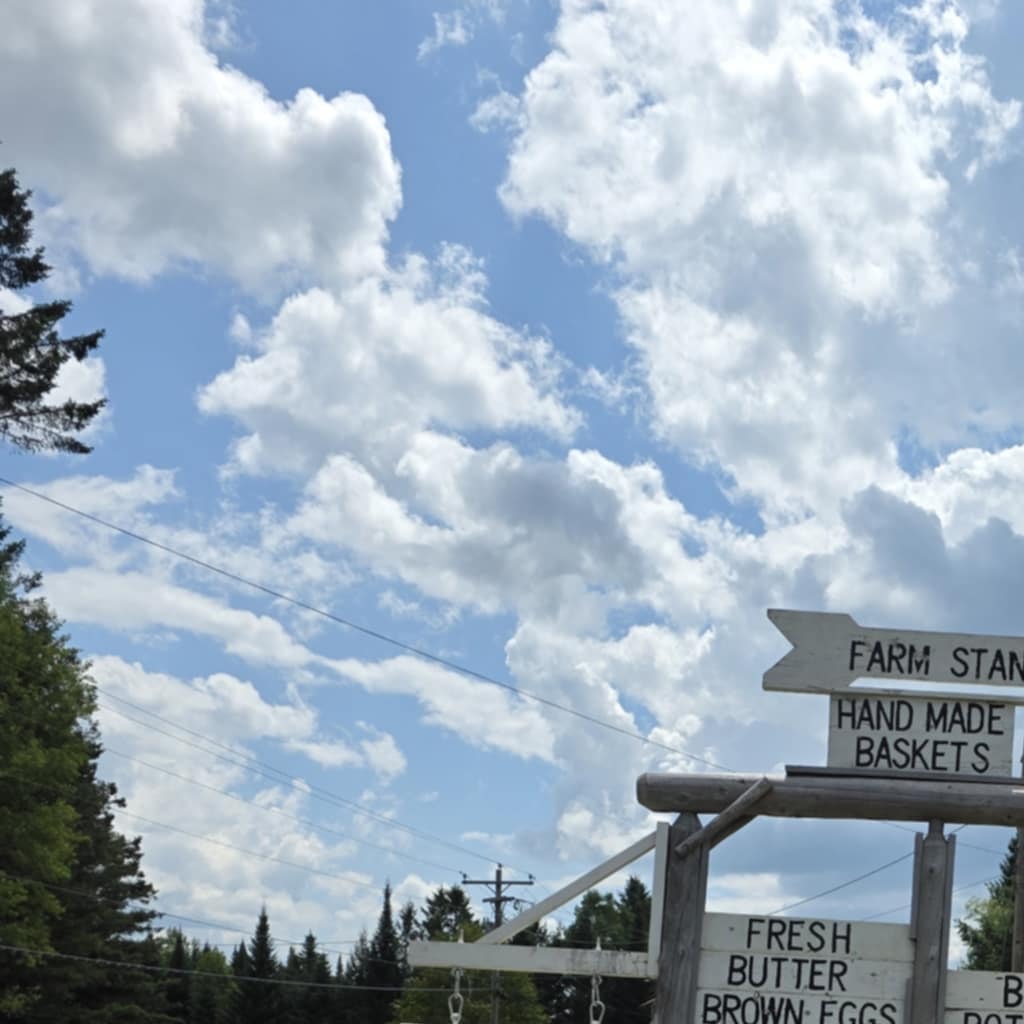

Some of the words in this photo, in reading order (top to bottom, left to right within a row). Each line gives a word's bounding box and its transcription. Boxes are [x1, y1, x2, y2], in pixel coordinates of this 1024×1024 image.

[849, 640, 930, 675] FARM
[837, 698, 913, 732] HAND
[925, 702, 1005, 735] MADE
[855, 736, 990, 774] BASKETS
[746, 918, 851, 954] FRESH
[727, 955, 848, 992] BUTTER
